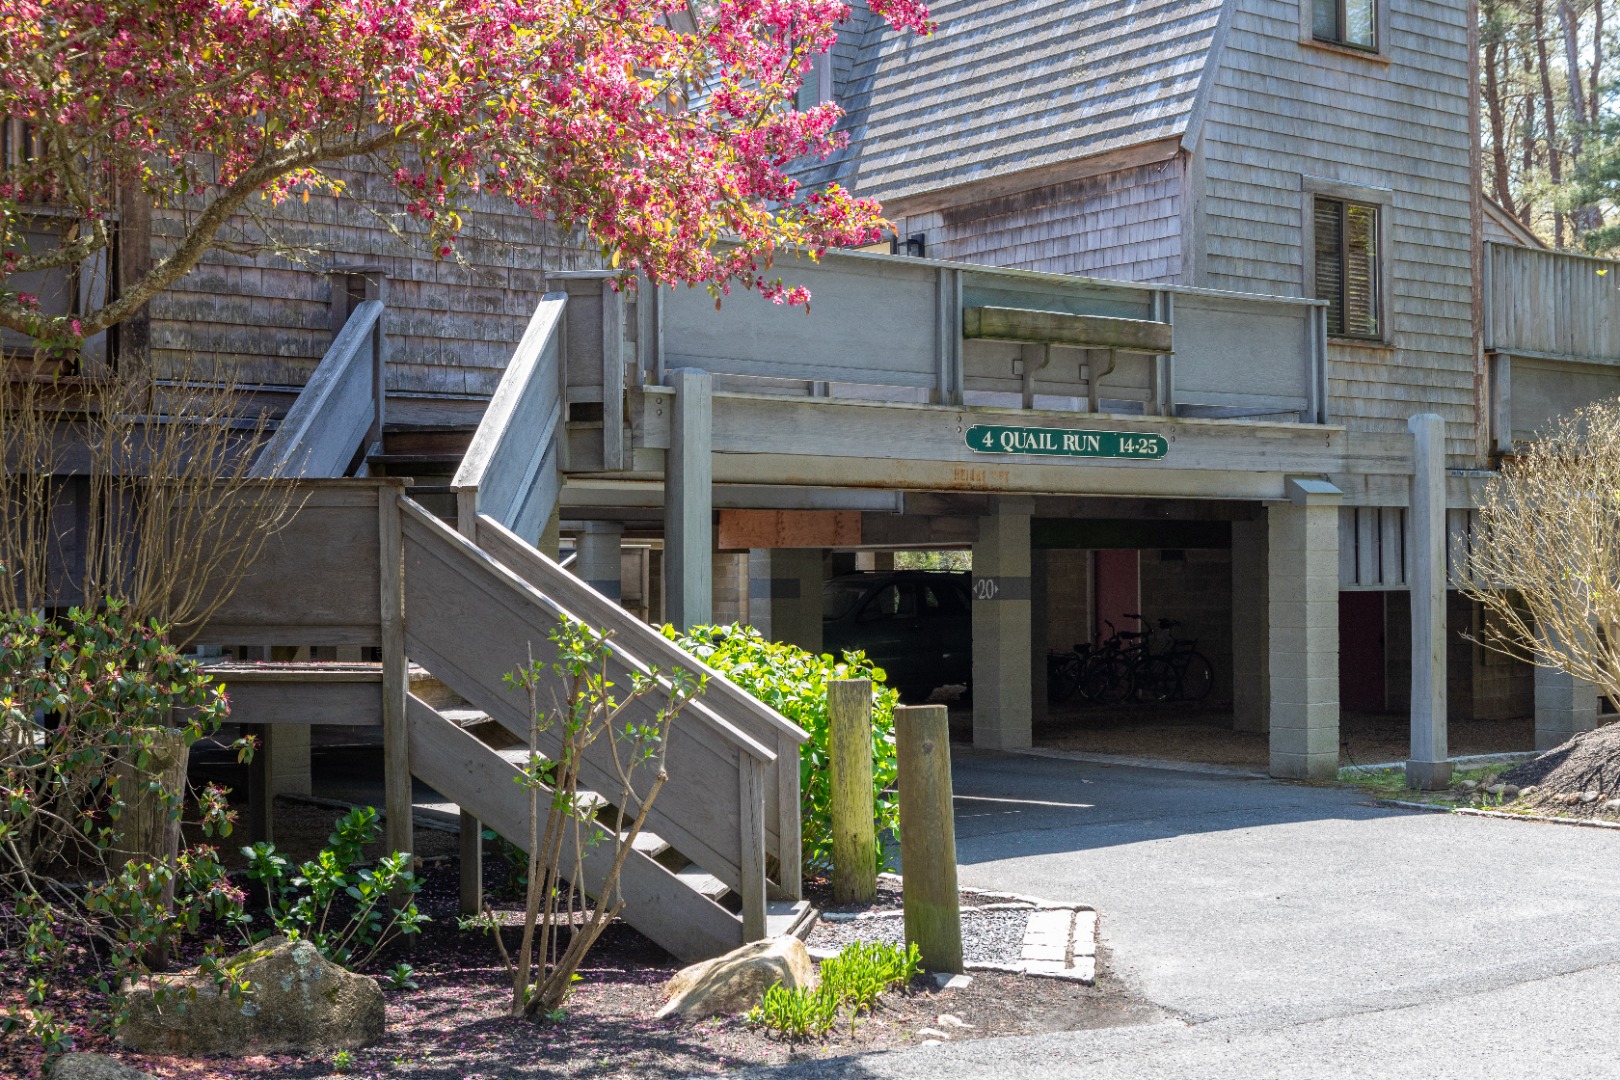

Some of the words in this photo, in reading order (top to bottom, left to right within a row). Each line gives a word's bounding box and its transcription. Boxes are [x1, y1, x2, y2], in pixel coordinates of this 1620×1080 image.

[982, 431, 994, 447] 4
[1000, 431, 1058, 452] QUAIL
[1063, 434, 1101, 452] RUN
[1119, 437, 1158, 454] 14-25
[978, 579, 994, 599] 20
